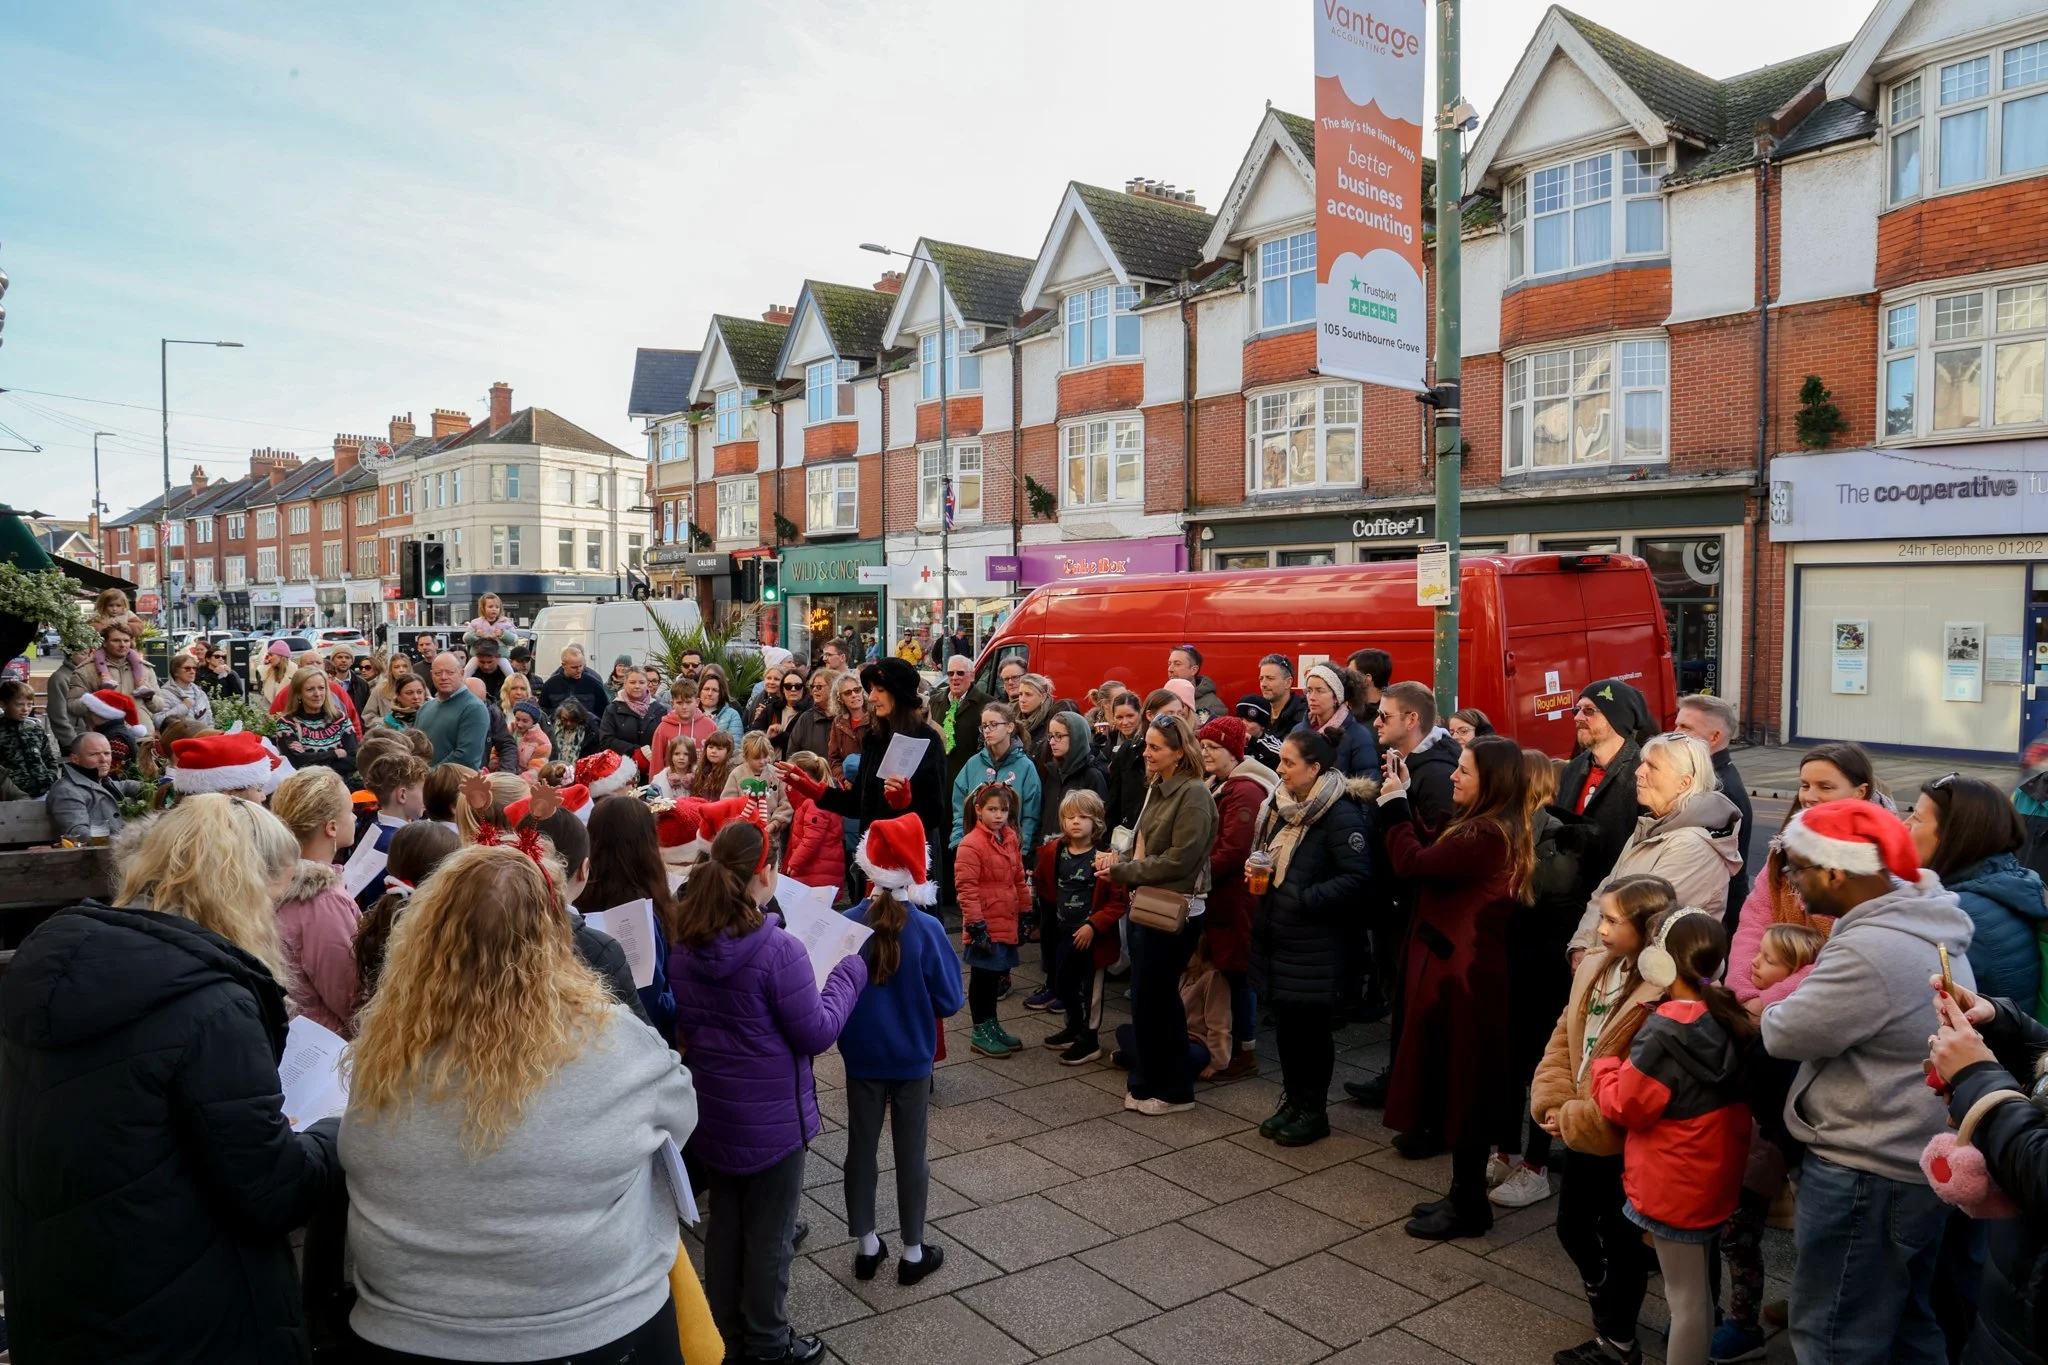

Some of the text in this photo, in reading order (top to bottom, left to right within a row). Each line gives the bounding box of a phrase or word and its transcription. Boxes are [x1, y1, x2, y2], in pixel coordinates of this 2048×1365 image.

[1324, 0, 1419, 58] Vantage
[1331, 26, 1386, 56] ACCOUNTING
[1321, 117, 1416, 165] The sky's the limit with
[1348, 143, 1393, 179] better
[1337, 167, 1403, 210] business
[1327, 198, 1413, 245] accounting
[1362, 282, 1397, 302] Trustpilot
[1324, 322, 1420, 354] 105 Southbourne Grove
[1836, 483, 1869, 504] The
[1874, 475, 2018, 505] co-operative
[697, 558, 717, 567] CALIBER
[1898, 540, 2043, 558] 24hr Telephone 01202
[791, 561, 817, 581] WILD
[818, 560, 828, 580] &
[1063, 557, 1127, 574] Cake Box
[1704, 613, 1717, 659] House
[1537, 693, 1572, 711] Royal Mail
